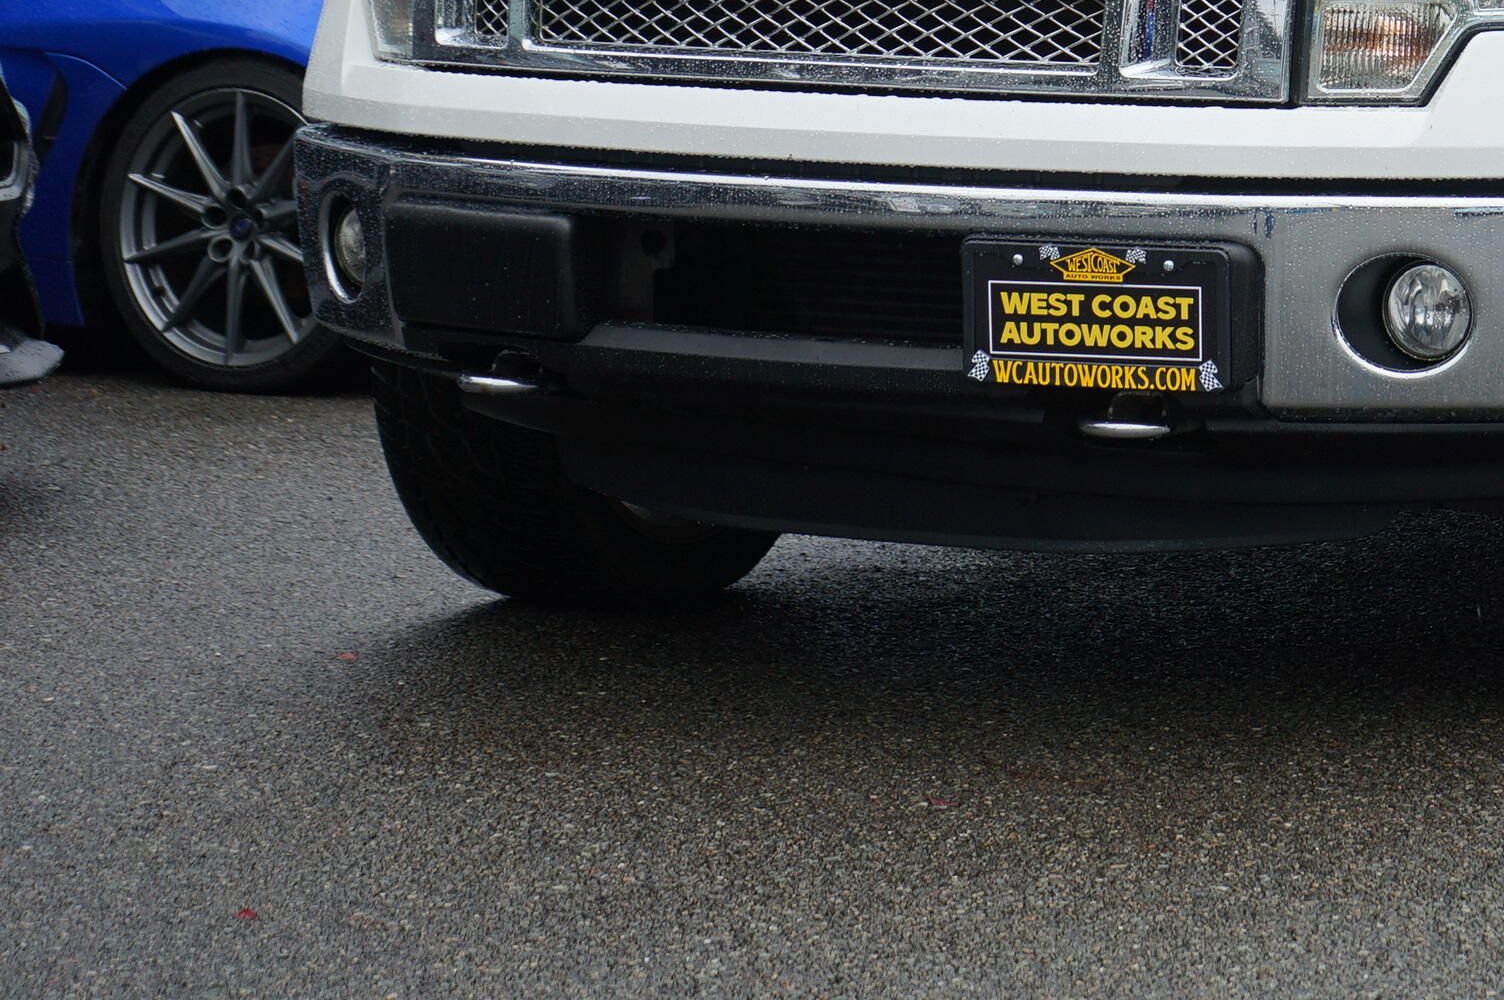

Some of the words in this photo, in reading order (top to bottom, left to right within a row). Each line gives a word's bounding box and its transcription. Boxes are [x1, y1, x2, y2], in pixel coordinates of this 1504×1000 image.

[1000, 291, 1085, 317] WEST
[1091, 294, 1194, 320] COAST
[999, 321, 1195, 351] AUTOWORKS
[992, 359, 1196, 392] WCAUTOWORKS.COM
